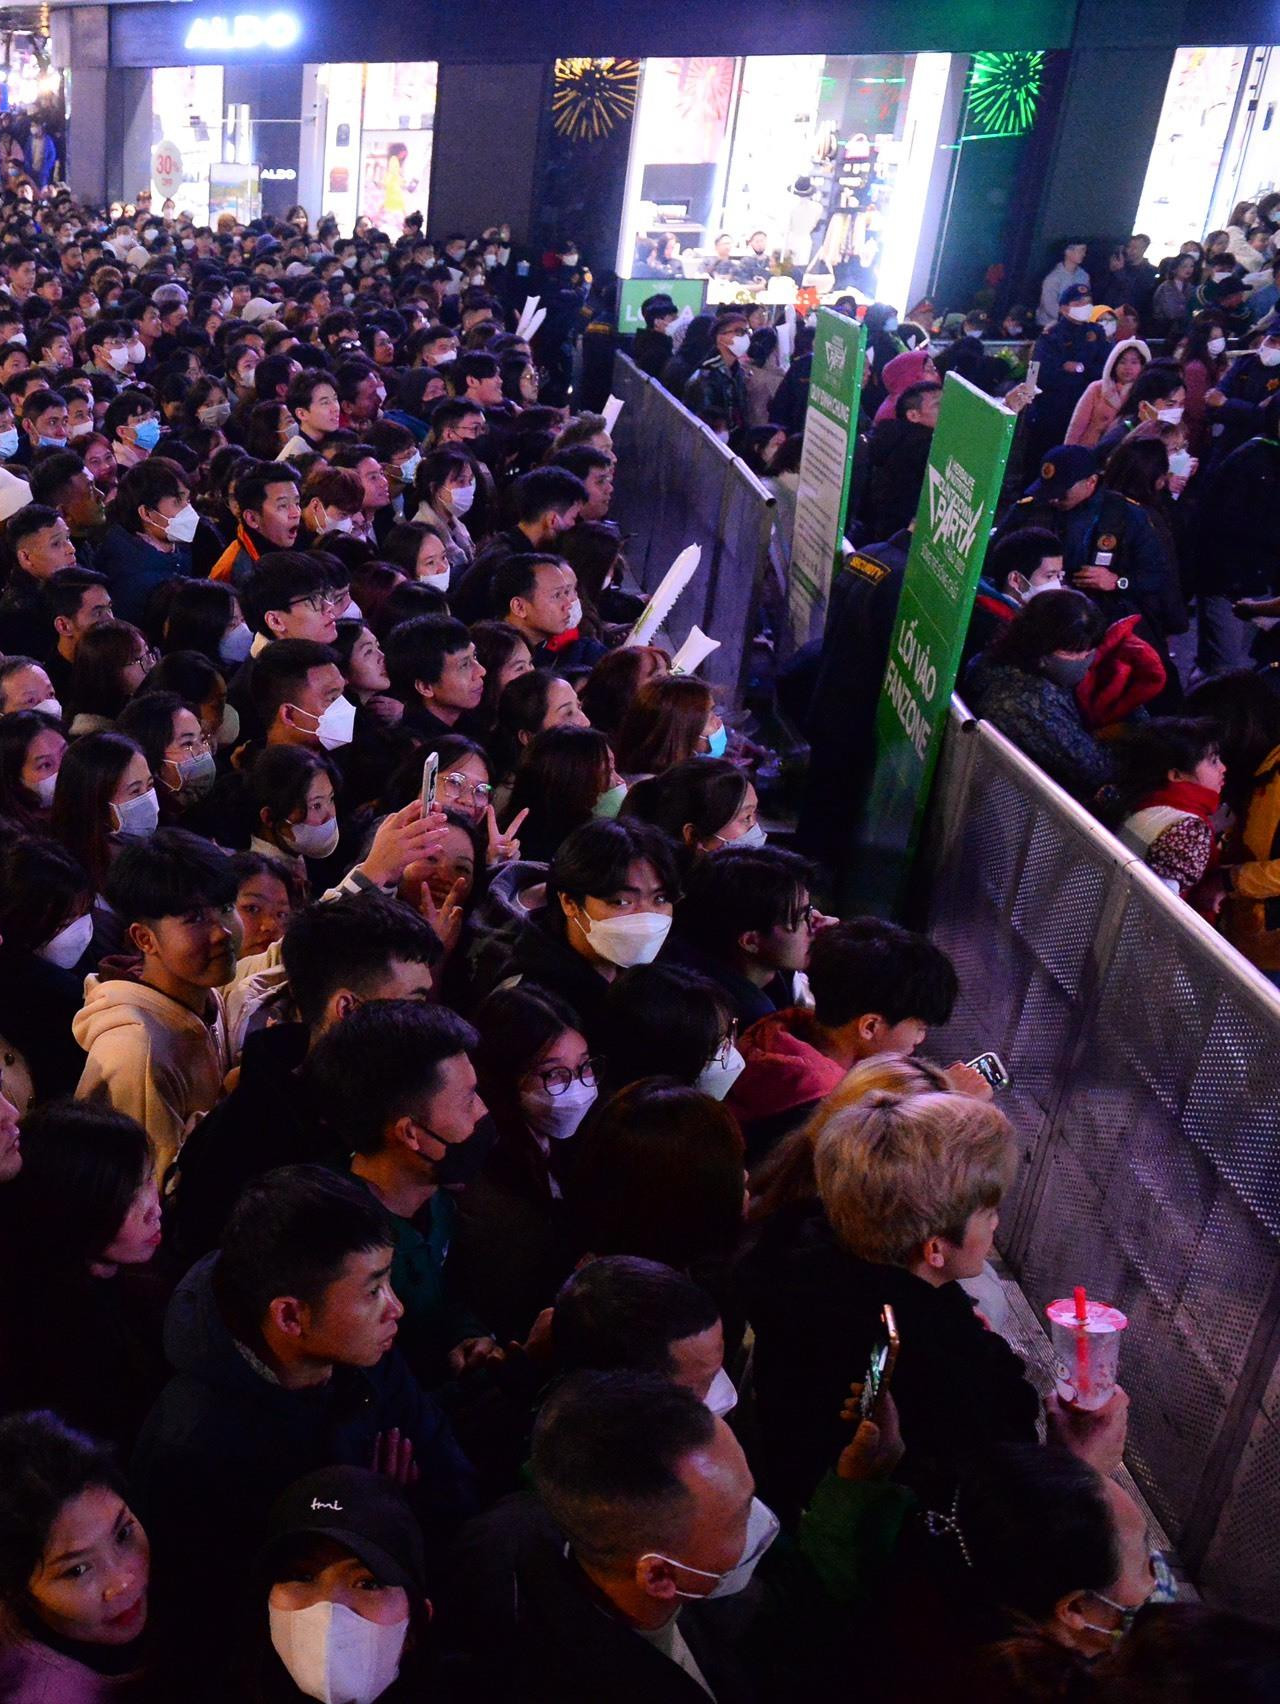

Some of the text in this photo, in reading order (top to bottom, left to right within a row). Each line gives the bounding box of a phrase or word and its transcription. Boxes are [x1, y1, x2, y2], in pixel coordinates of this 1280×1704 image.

[260, 168, 297, 180] ALDO
[914, 644, 936, 702] VÀO
[884, 659, 931, 761] FANZONE
